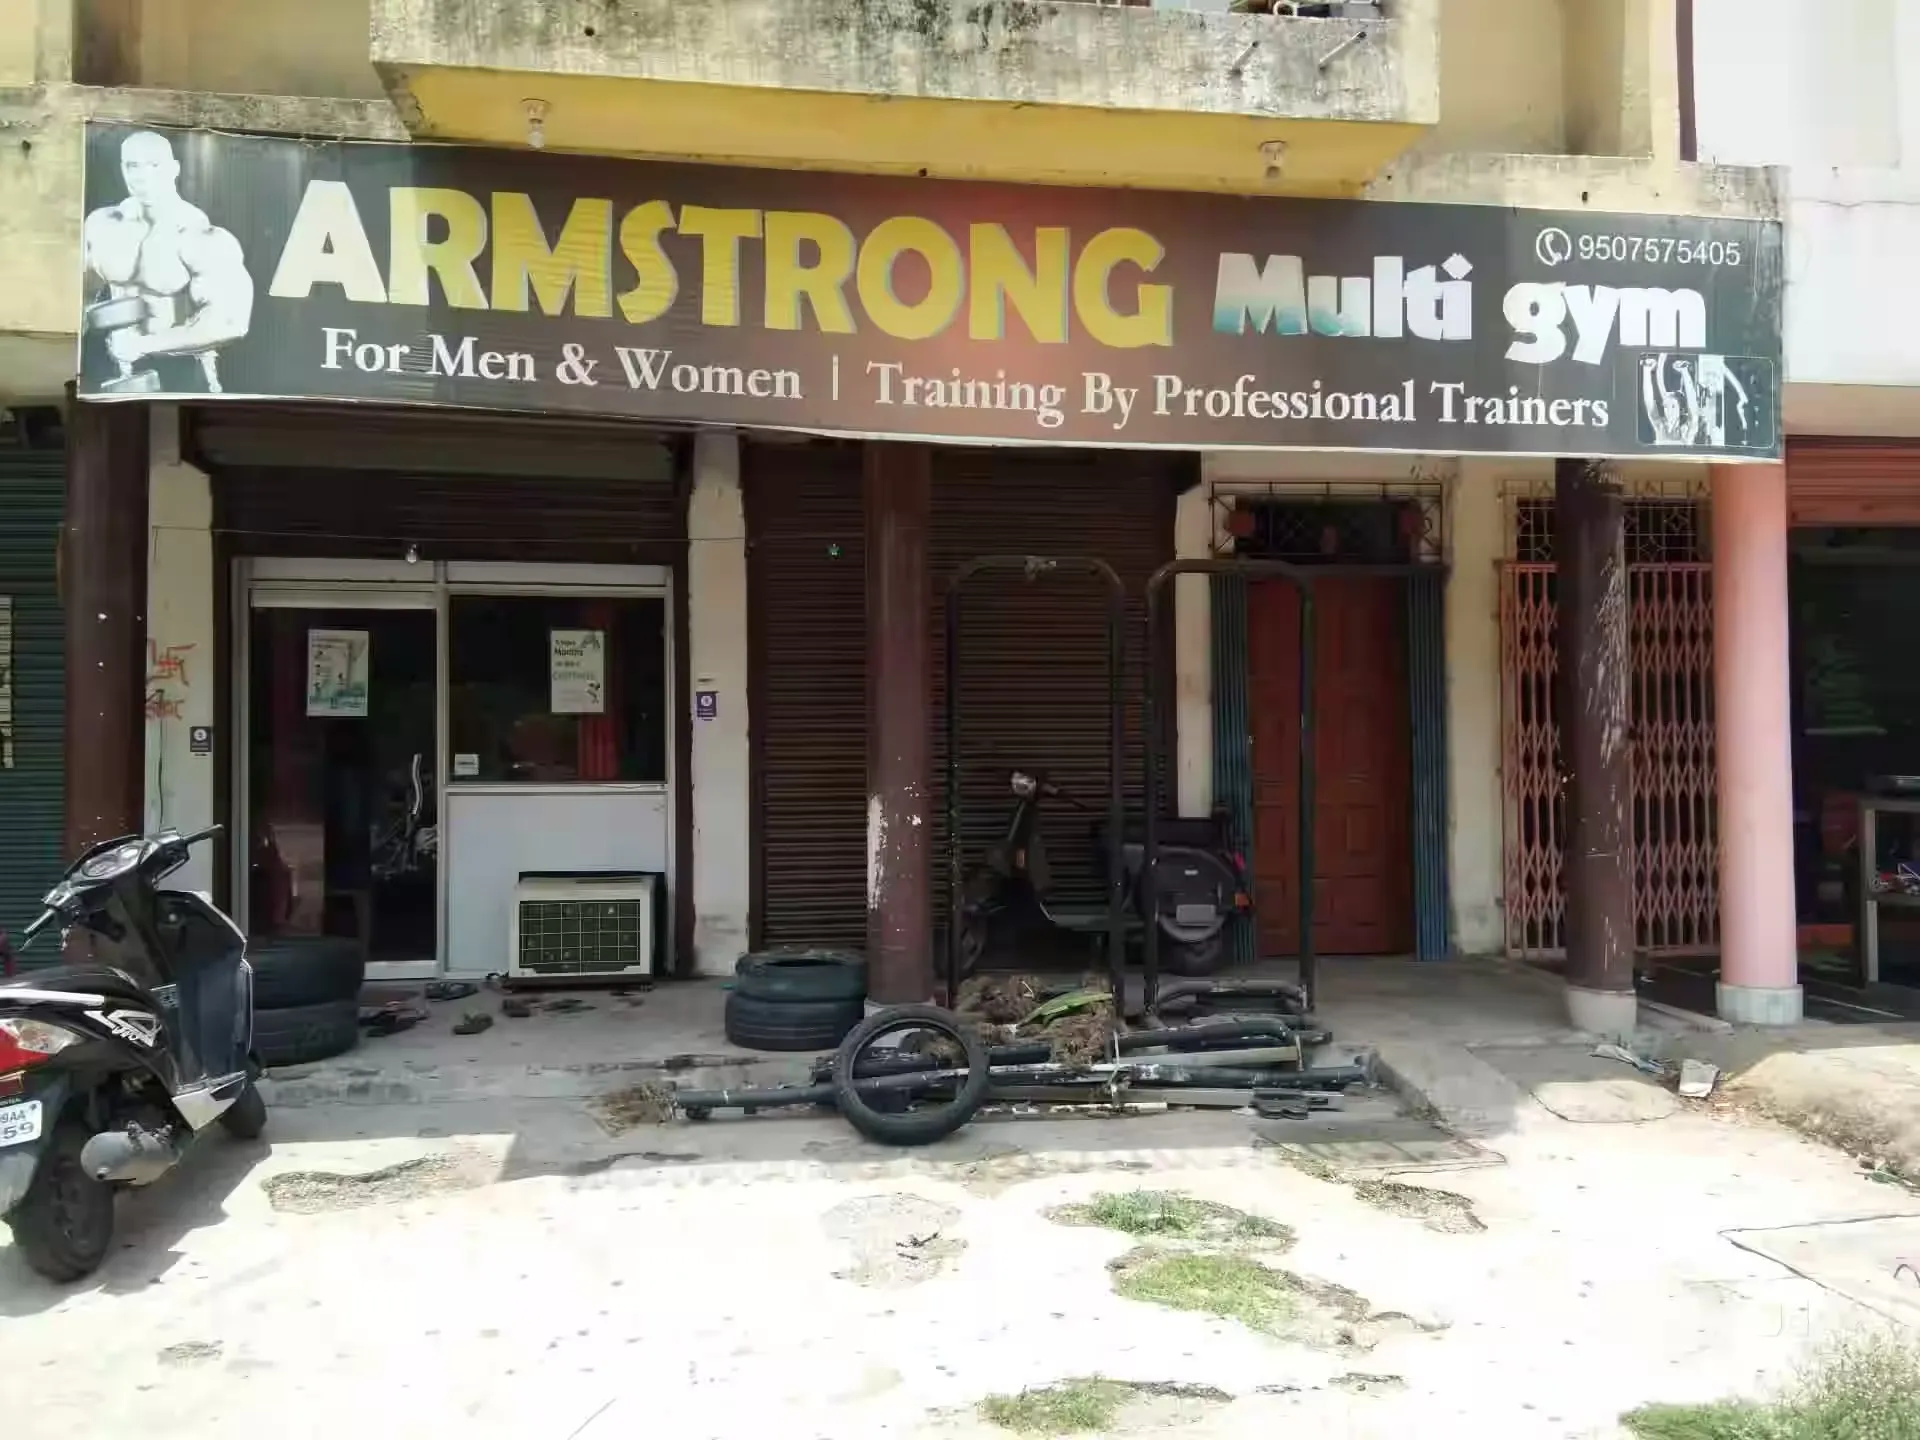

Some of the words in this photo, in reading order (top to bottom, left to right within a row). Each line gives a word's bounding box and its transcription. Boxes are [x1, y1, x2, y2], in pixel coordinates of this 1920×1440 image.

[269, 180, 1173, 348] ARMSTRONG
[1213, 252, 1474, 341] Multi
[1503, 281, 1706, 365] gym
[1578, 234, 1741, 266] 9507575405
[320, 327, 411, 373] For
[426, 334, 537, 382] Men
[556, 343, 598, 386] &
[614, 346, 803, 399] Women
[866, 361, 1066, 428] Training
[1081, 372, 1139, 430] By
[1152, 374, 1417, 422] Professional
[1430, 381, 1609, 428] Trainers
